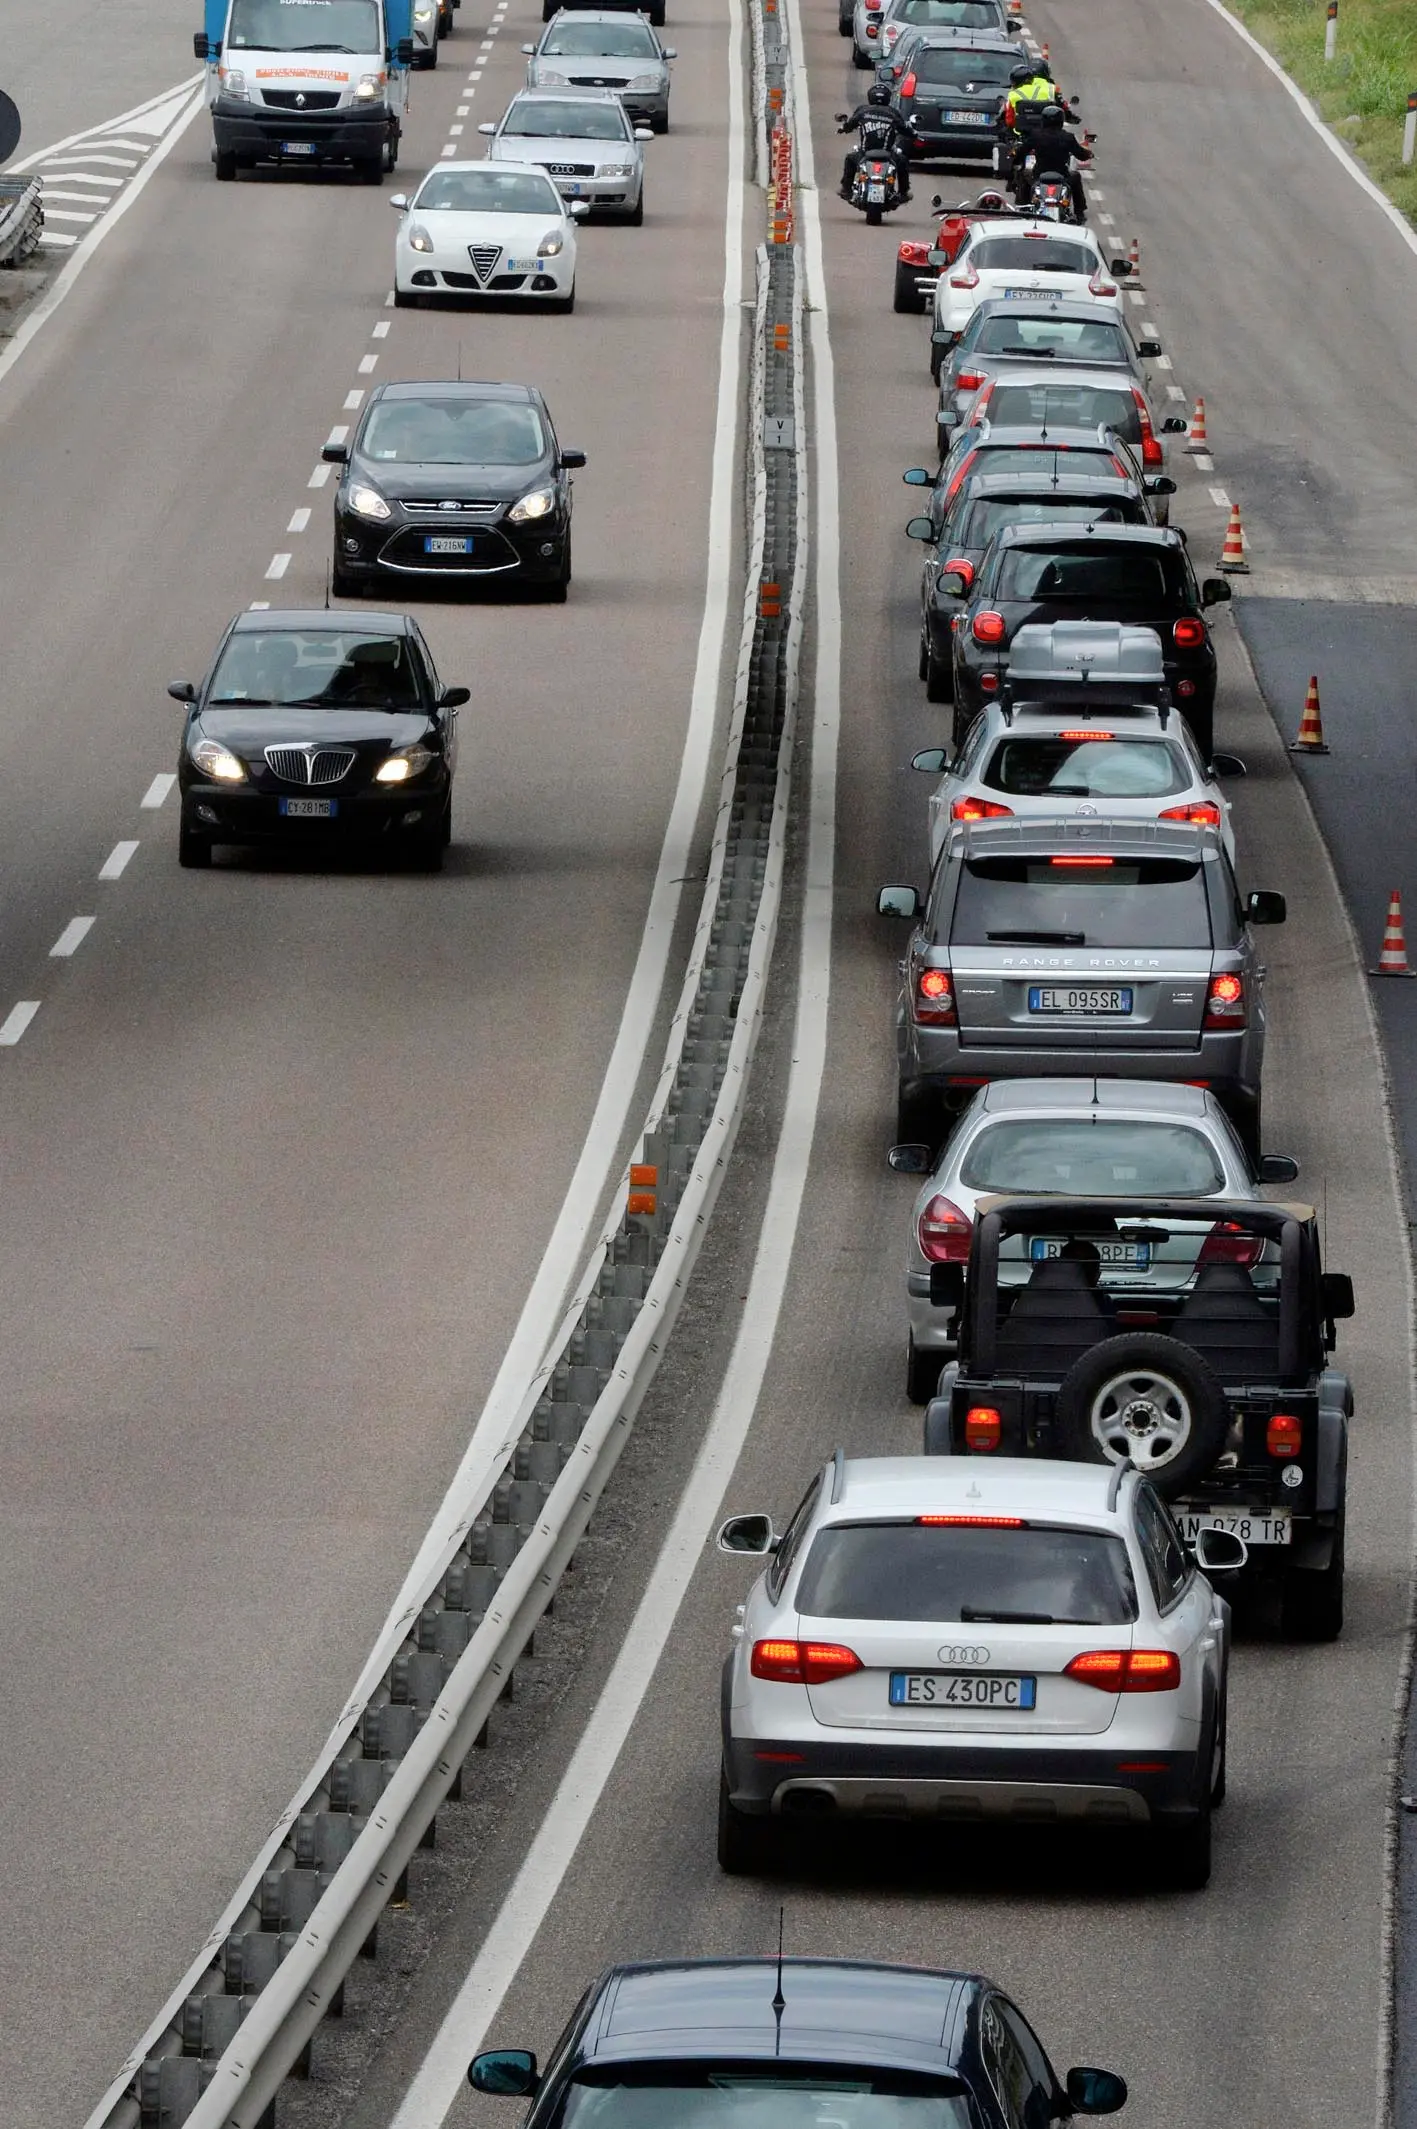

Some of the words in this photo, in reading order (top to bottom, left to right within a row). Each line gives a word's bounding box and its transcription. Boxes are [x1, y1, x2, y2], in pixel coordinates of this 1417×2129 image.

[777, 420, 784, 430] V
[1002, 958, 1075, 967] RANGE
[1089, 958, 1160, 967] ROVER
[1041, 991, 1061, 1008] EL
[1068, 991, 1119, 1009] 095SR
[1261, 1519, 1285, 1541] TR
[907, 1677, 936, 1701] ES
[946, 1678, 1018, 1704] 430PC
